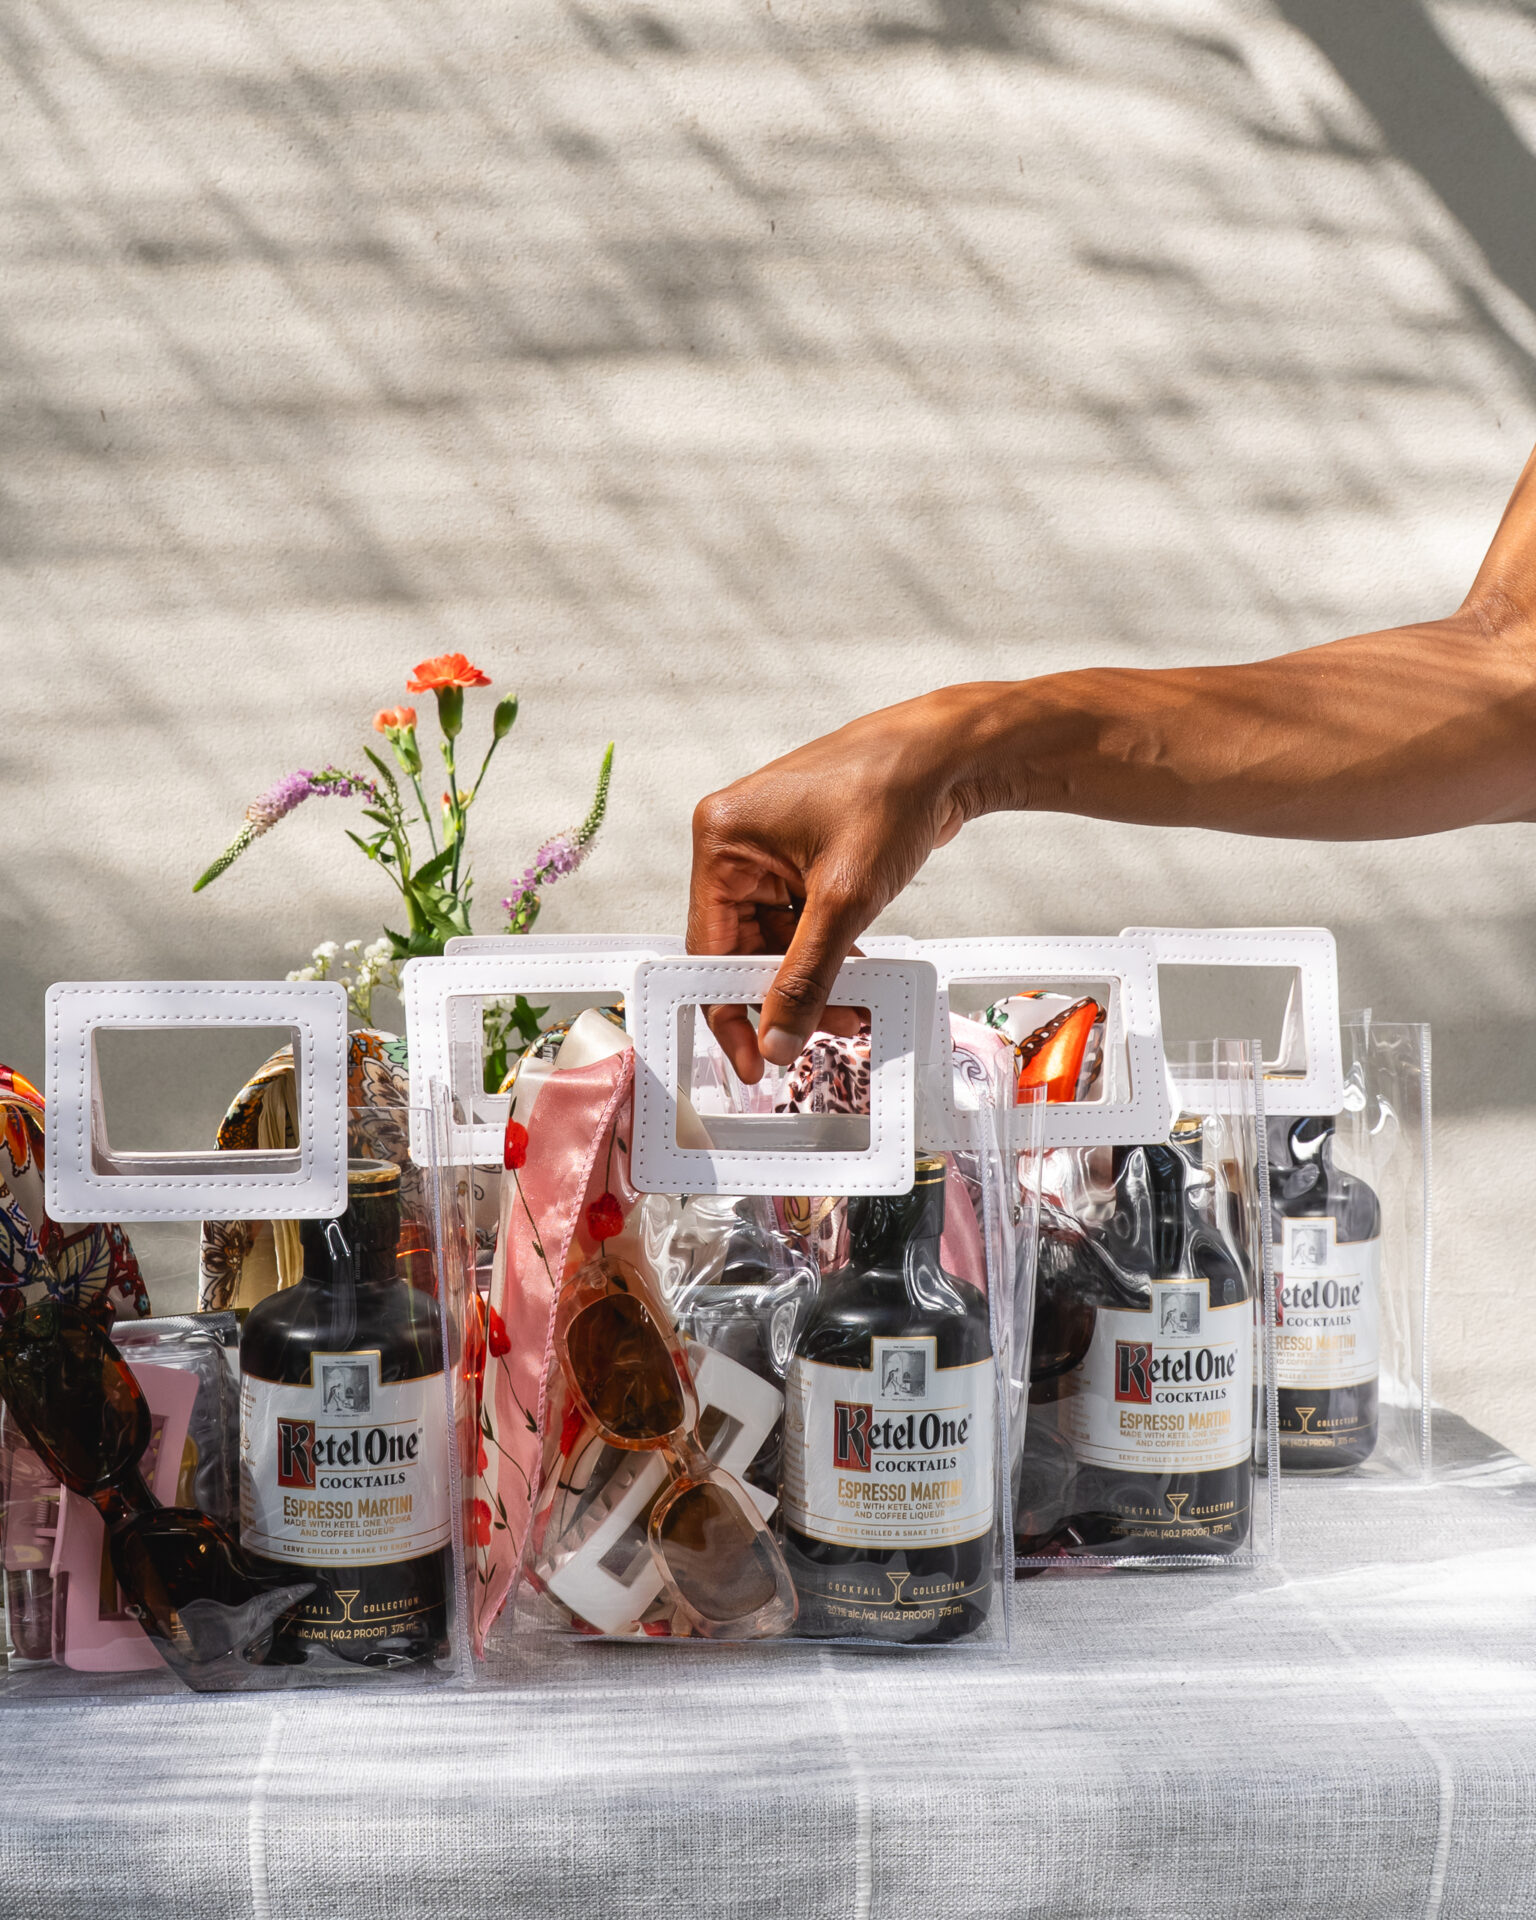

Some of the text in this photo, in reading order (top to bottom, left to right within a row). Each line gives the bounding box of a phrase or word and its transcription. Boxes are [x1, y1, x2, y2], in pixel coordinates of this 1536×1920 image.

[1287, 1315, 1352, 1327] COCKTAILS
[1276, 1335, 1312, 1351] RESSO
[1118, 1345, 1192, 1399] Ketel
[1155, 1388, 1227, 1403] COCKTAILS
[1120, 1410, 1184, 1431] ESPRESSO
[836, 1407, 916, 1467] Ketel
[1144, 1431, 1164, 1439] WITH
[1155, 1440, 1185, 1448] COFFEE
[279, 1424, 360, 1484] Ketel
[875, 1457, 957, 1472] COCKTAILS
[320, 1472, 406, 1489] COCKTAILS
[838, 1478, 906, 1502] ESPRESSO
[283, 1494, 413, 1519] ESPRESSO MARTINI
[863, 1502, 885, 1511] WITH
[887, 1503, 912, 1511] KETEL
[915, 1502, 933, 1510] ONE
[1191, 1501, 1234, 1515] COLLECTION
[854, 1510, 945, 1520] AND COFFEE LIQUEUR
[284, 1518, 307, 1527] MADE
[309, 1520, 331, 1529] WITH
[334, 1520, 360, 1529] KETEL
[363, 1519, 381, 1528] ONE
[300, 1527, 396, 1538] AND COFFEE LIQUEUR
[861, 1529, 892, 1537] CHILLED
[283, 1544, 305, 1554] SERVE
[828, 1581, 965, 1596] COCKTAIL COLLECTION
[363, 1597, 420, 1614] COLLECTION
[902, 1609, 935, 1620] PROOF)
[353, 1626, 388, 1639] PROOF)
